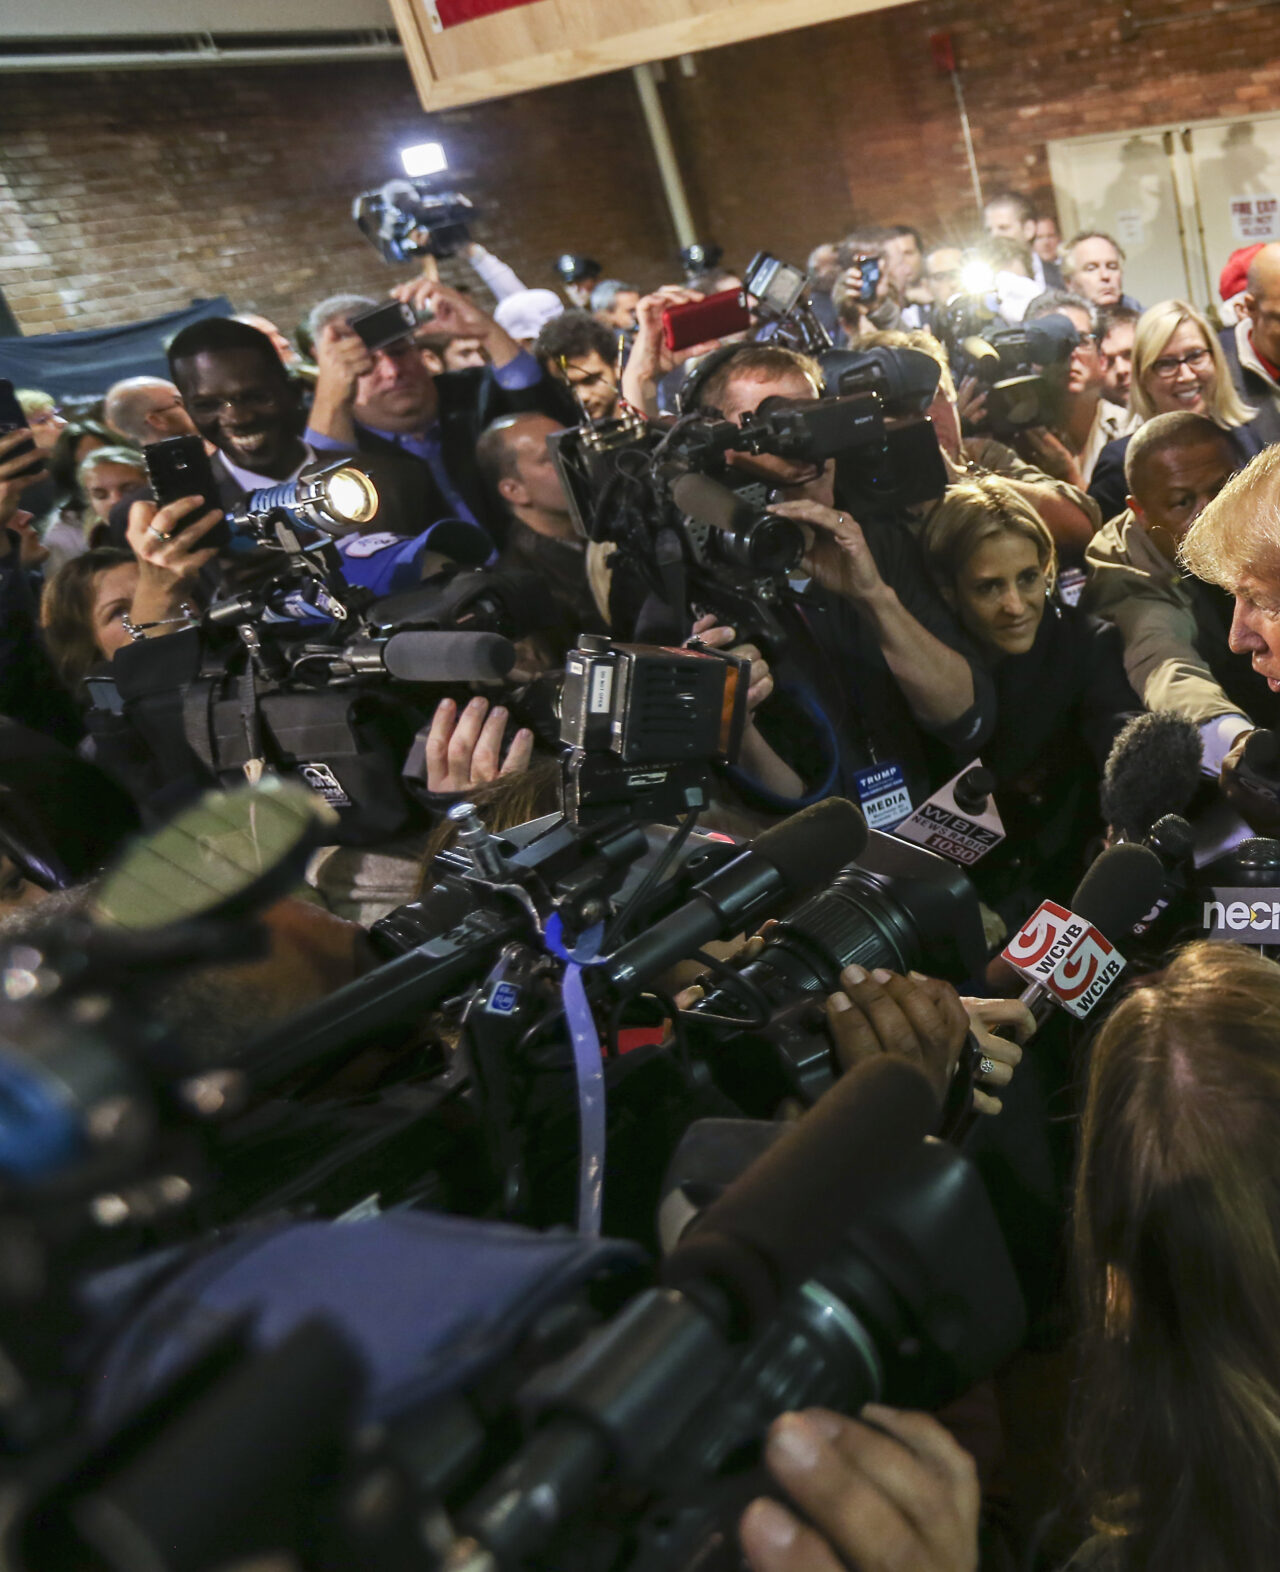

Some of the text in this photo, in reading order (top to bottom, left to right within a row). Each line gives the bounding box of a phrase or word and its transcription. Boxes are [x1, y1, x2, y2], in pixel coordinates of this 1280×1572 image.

[860, 766, 897, 787] TRUMP
[867, 792, 906, 815] MEDIA
[925, 806, 995, 843] WBZ
[931, 836, 975, 860] 1030
[1035, 923, 1083, 975] WCVB
[1076, 959, 1121, 1012] WCVB
